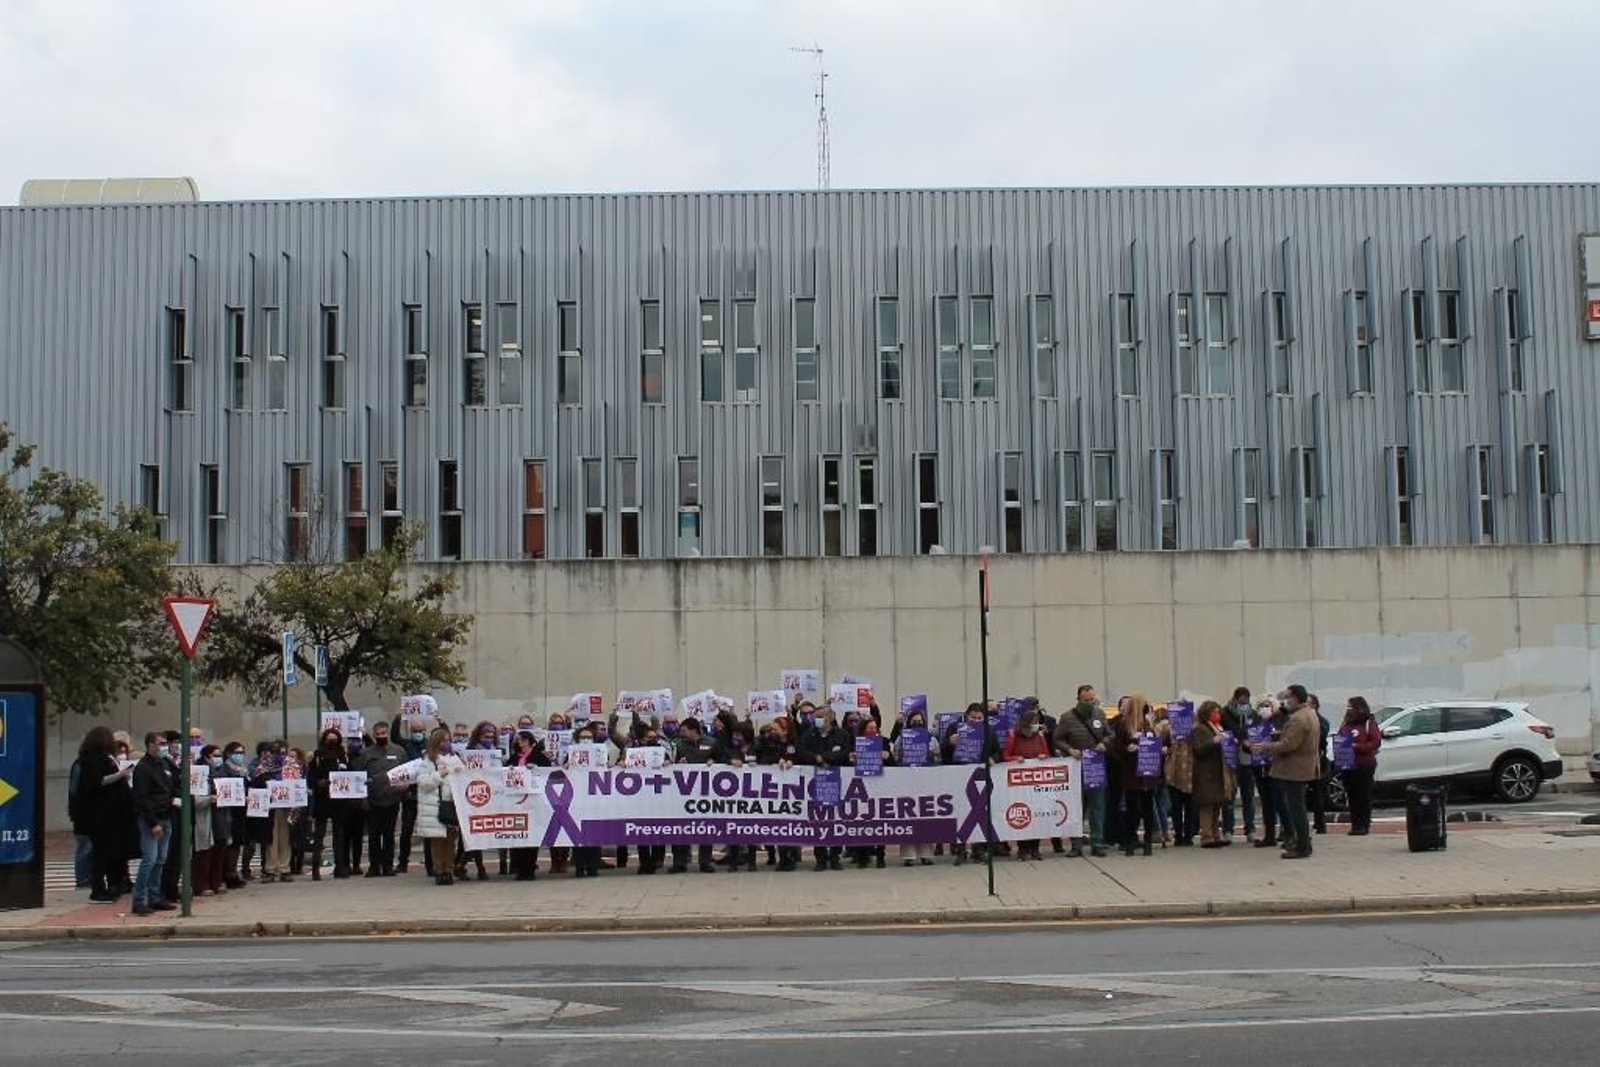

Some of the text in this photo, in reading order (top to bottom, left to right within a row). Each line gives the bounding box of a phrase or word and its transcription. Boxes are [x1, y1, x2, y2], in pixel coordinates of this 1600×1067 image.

[588, 771, 869, 802] NO+VIOLENA
[684, 800, 802, 815] CONTRA LAS
[807, 795, 954, 821] MUJERES
[16, 829, 29, 841] 23
[625, 822, 914, 839] Prevención, Protección y Derechos
